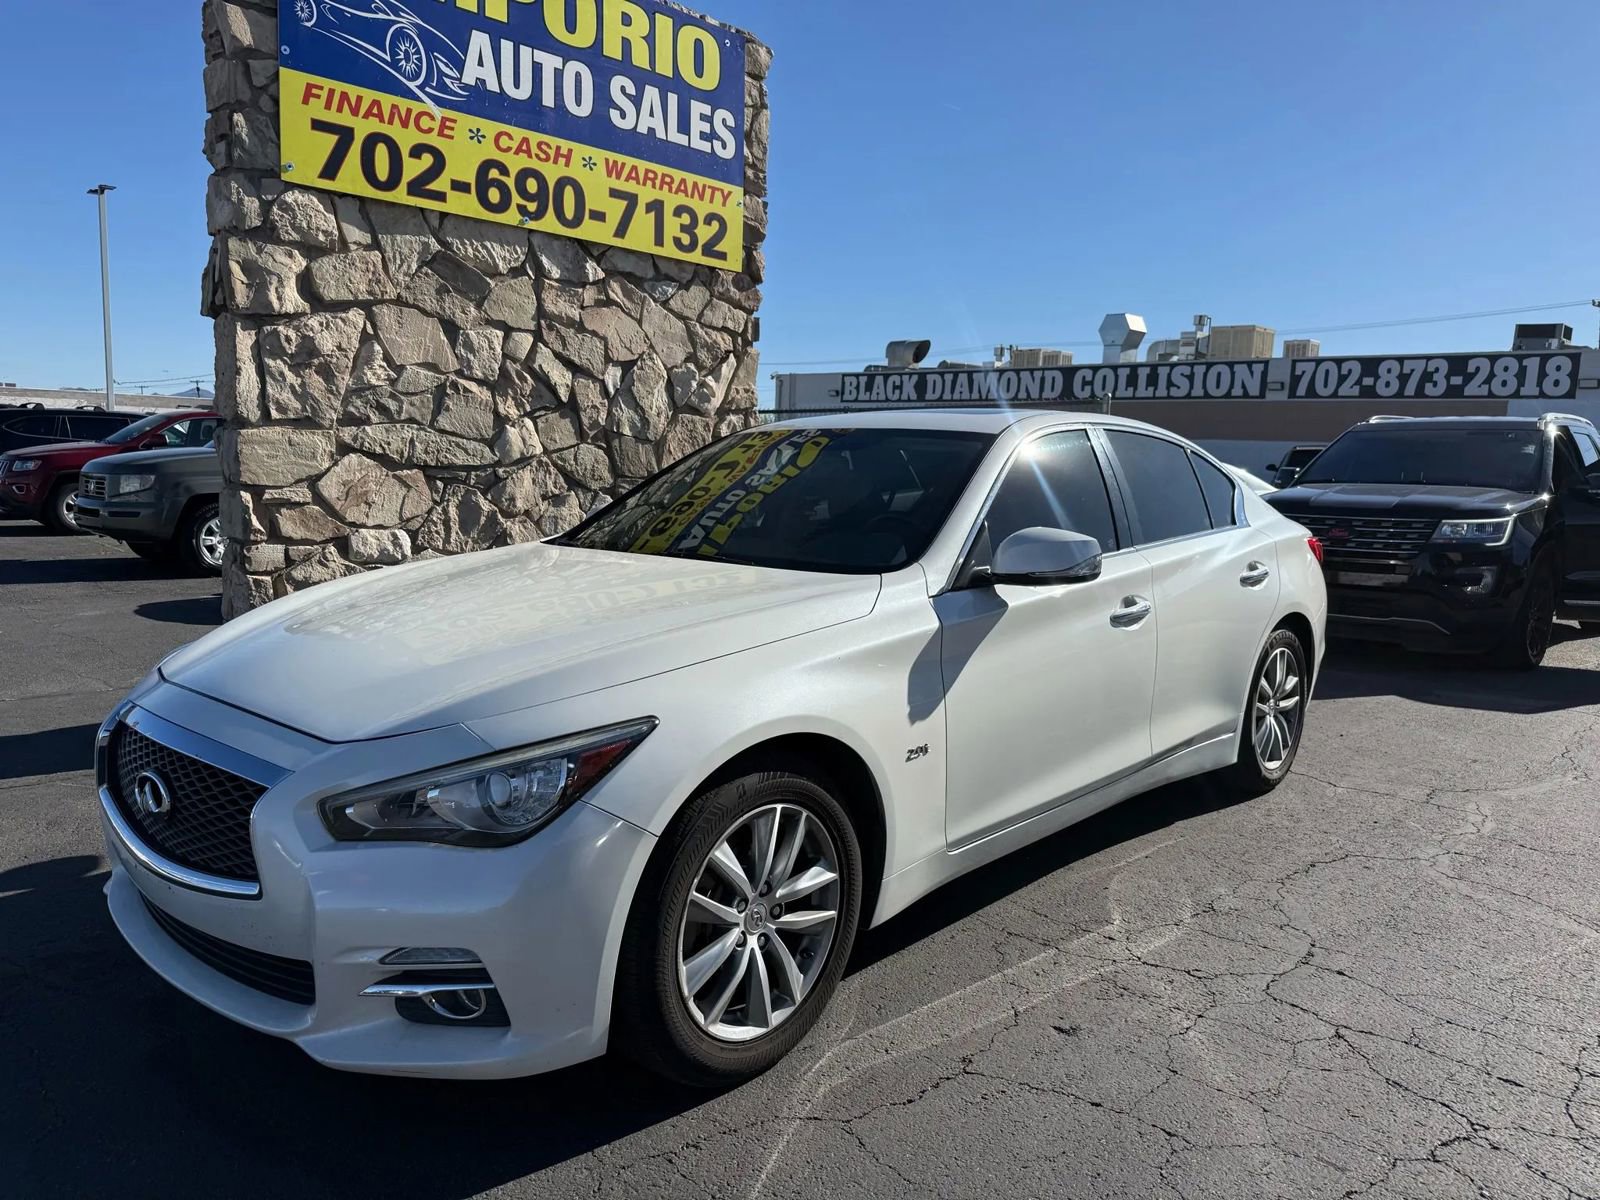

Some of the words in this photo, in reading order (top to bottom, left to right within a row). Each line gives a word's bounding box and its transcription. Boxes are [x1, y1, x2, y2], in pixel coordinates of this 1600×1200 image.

[455, 0, 720, 91] ORIO
[461, 29, 594, 118] AUTO
[609, 75, 736, 160] SALES
[301, 82, 458, 140] FINANCE
[493, 131, 573, 168] CASH
[604, 157, 733, 207] WARRANTY
[310, 117, 728, 261] 702-690-7132
[843, 374, 918, 400] BLACK
[925, 370, 1063, 400] DIAMOND
[1073, 363, 1265, 399] COLLISION
[1295, 356, 1573, 397] 702-873-2818
